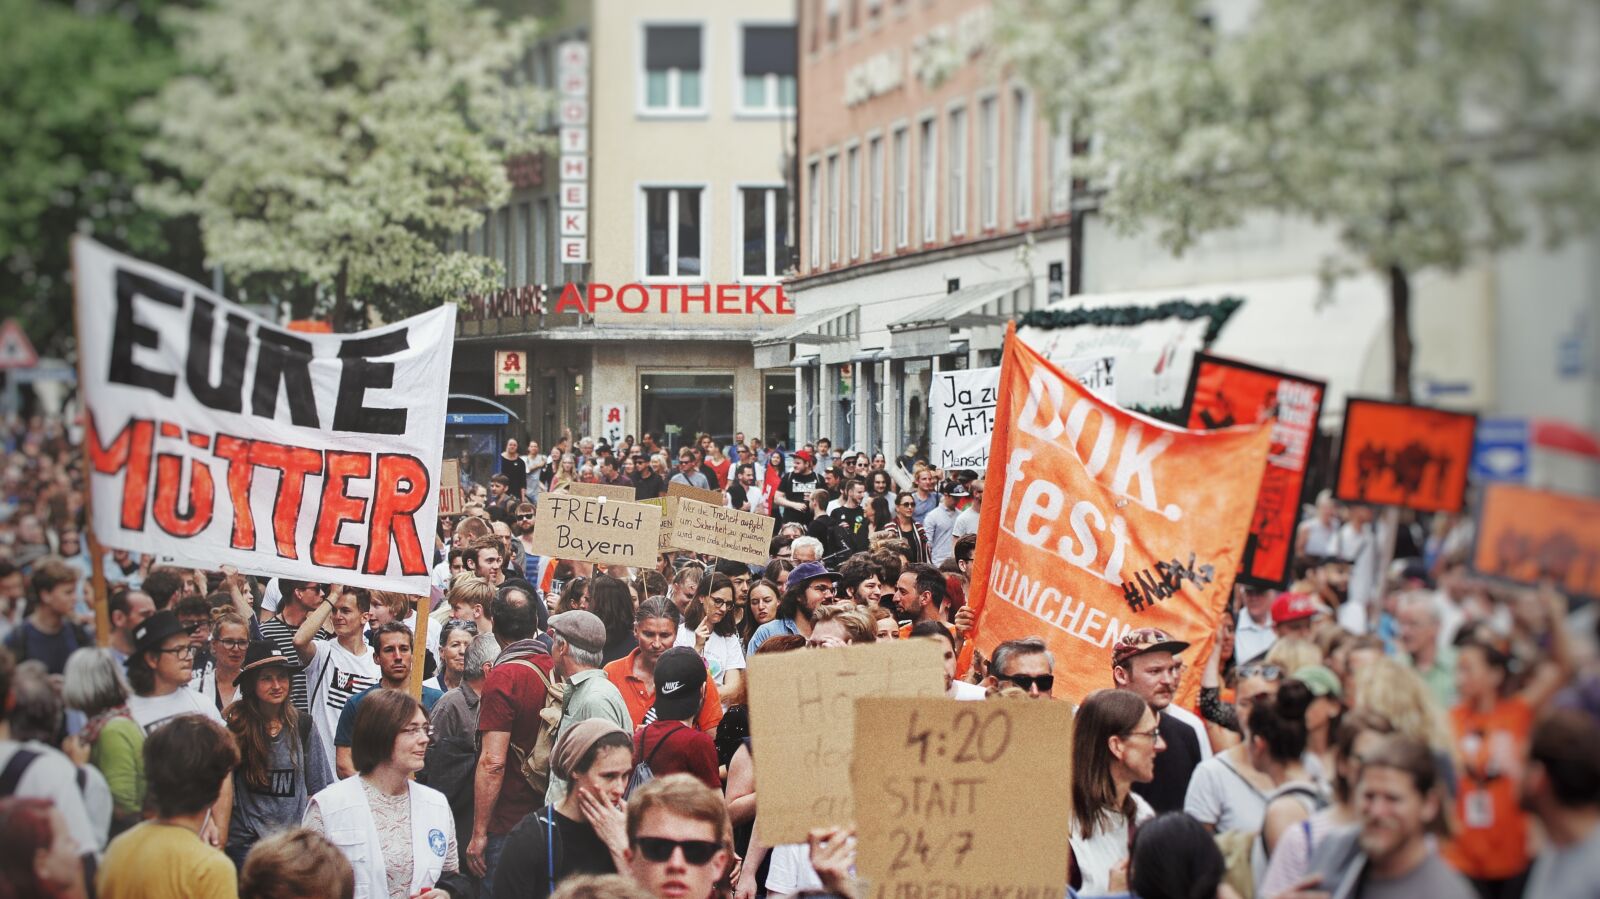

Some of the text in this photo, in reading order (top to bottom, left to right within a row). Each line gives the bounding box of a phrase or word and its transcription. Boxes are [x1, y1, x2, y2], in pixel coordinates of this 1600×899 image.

[564, 53, 584, 259] APOTHEKE
[555, 281, 796, 315] APOTHEKE
[107, 267, 409, 436] EURE
[944, 376, 971, 407] Ja
[1017, 364, 1183, 522] DOK.
[84, 407, 430, 576] MÜTTER
[548, 498, 643, 530] FREIstaat
[680, 518, 692, 527] um
[693, 518, 727, 535] Sicherheit
[682, 500, 695, 514] Wer
[710, 506, 739, 524] Freiheit
[1001, 447, 1129, 587] fest
[556, 525, 634, 558] Bayern
[696, 535, 706, 543] am
[664, 681, 680, 690] NIKE
[906, 707, 1012, 765] 4:20
[884, 776, 986, 819] STATT
[888, 827, 974, 875] 24/7
